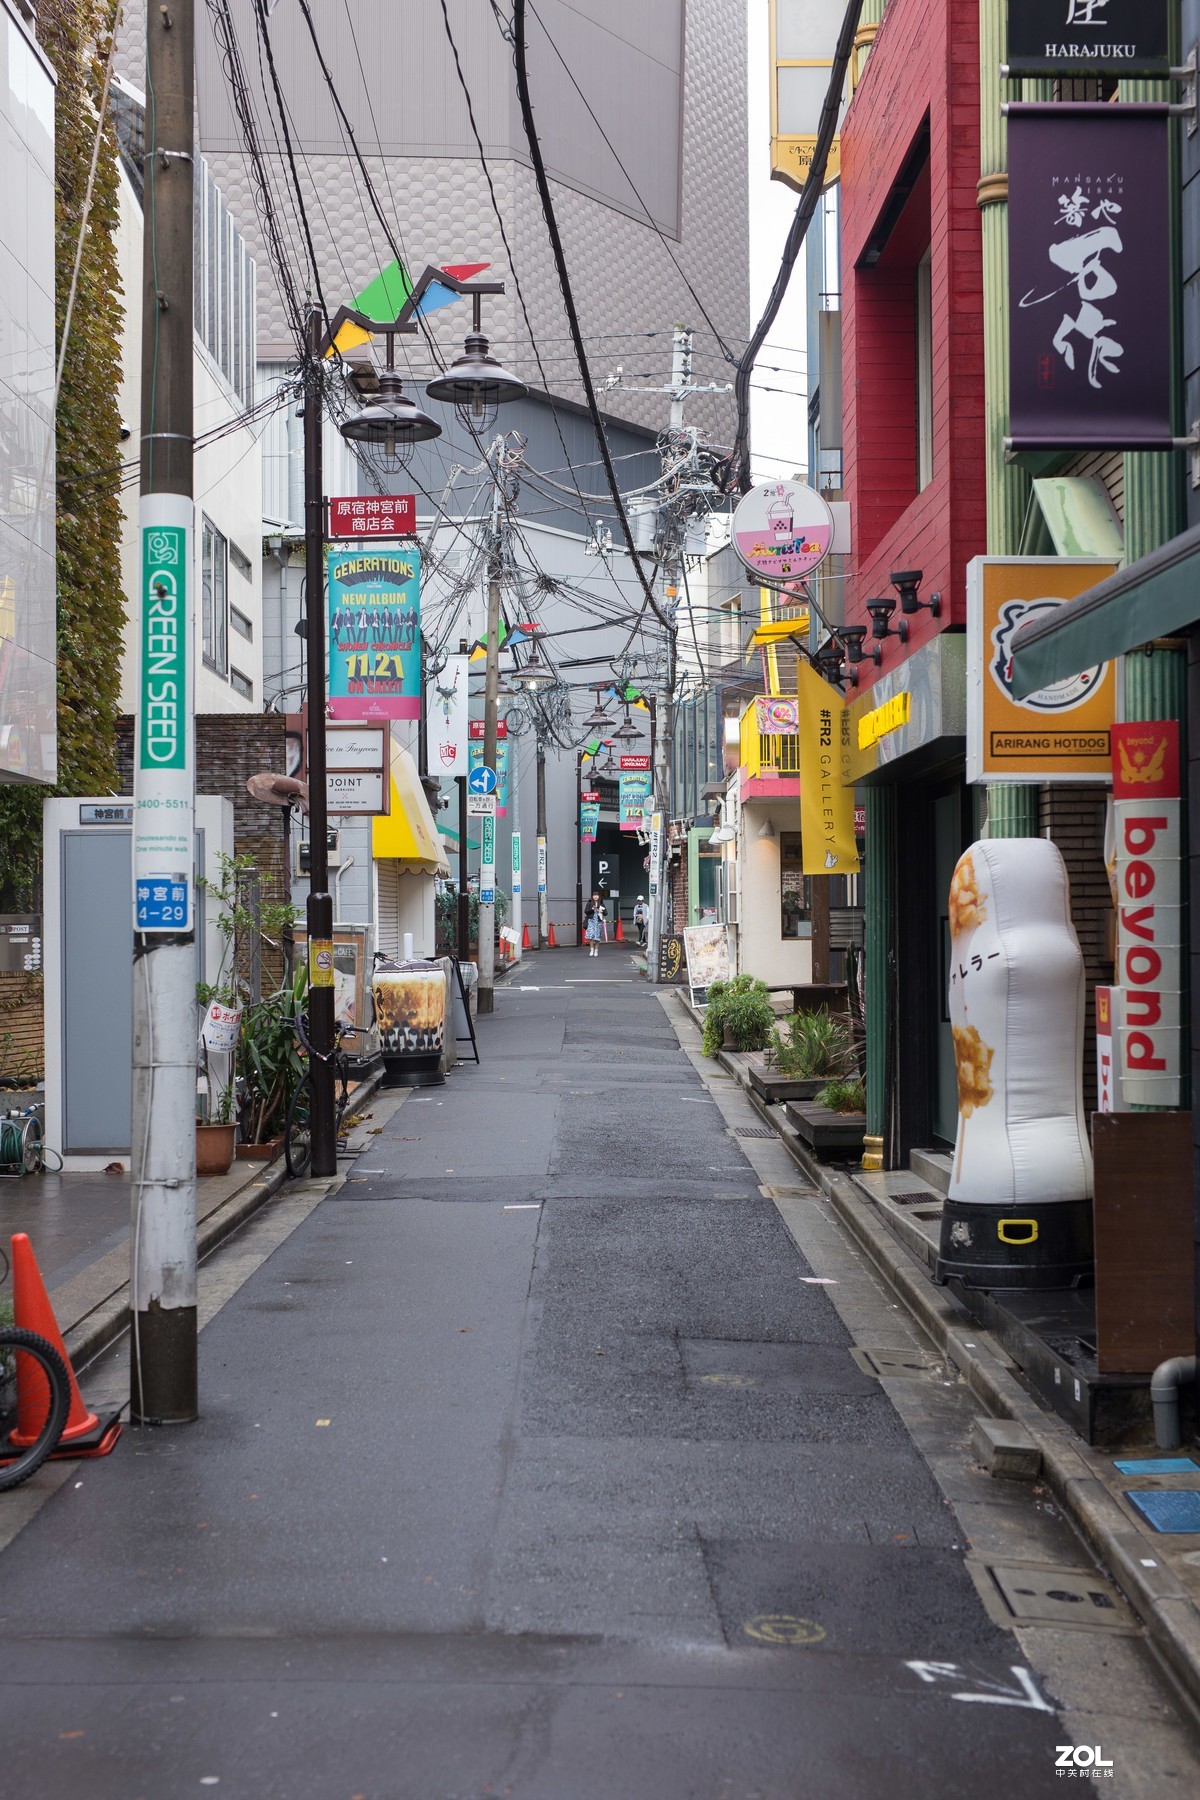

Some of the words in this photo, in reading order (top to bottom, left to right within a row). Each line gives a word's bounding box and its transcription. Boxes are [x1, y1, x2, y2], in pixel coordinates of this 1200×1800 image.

[1045, 44, 1136, 58] HARAJUKU
[1052, 173, 1124, 187] MANSAKU
[337, 500, 409, 515] 原宿神宮前
[352, 516, 395, 531] 商店会
[333, 557, 415, 580] GENERATIONS
[342, 593, 367, 605] NEW
[369, 592, 407, 605] ALBUM
[148, 569, 177, 675] GREEN
[345, 653, 405, 680] 11.21
[347, 681, 364, 694] ON
[1037, 687, 1080, 701] HANDMADE
[147, 681, 177, 763] SEED
[819, 708, 832, 747] #FR2
[995, 738, 1050, 749] ARIRANG
[1053, 738, 1106, 749] HOTDOG
[1127, 737, 1154, 747] beyond
[329, 778, 363, 788] JOINT
[820, 755, 836, 845] GALLERY
[94, 809, 125, 820] 神宮前
[484, 816, 493, 842] GREEN
[484, 843, 493, 863] SEED
[599, 861, 609, 874] P
[138, 887, 185, 902] 神宮前
[138, 906, 184, 921] 4-29
[1121, 816, 1168, 1071] beyond
[660, 938, 669, 977] WELCOME
